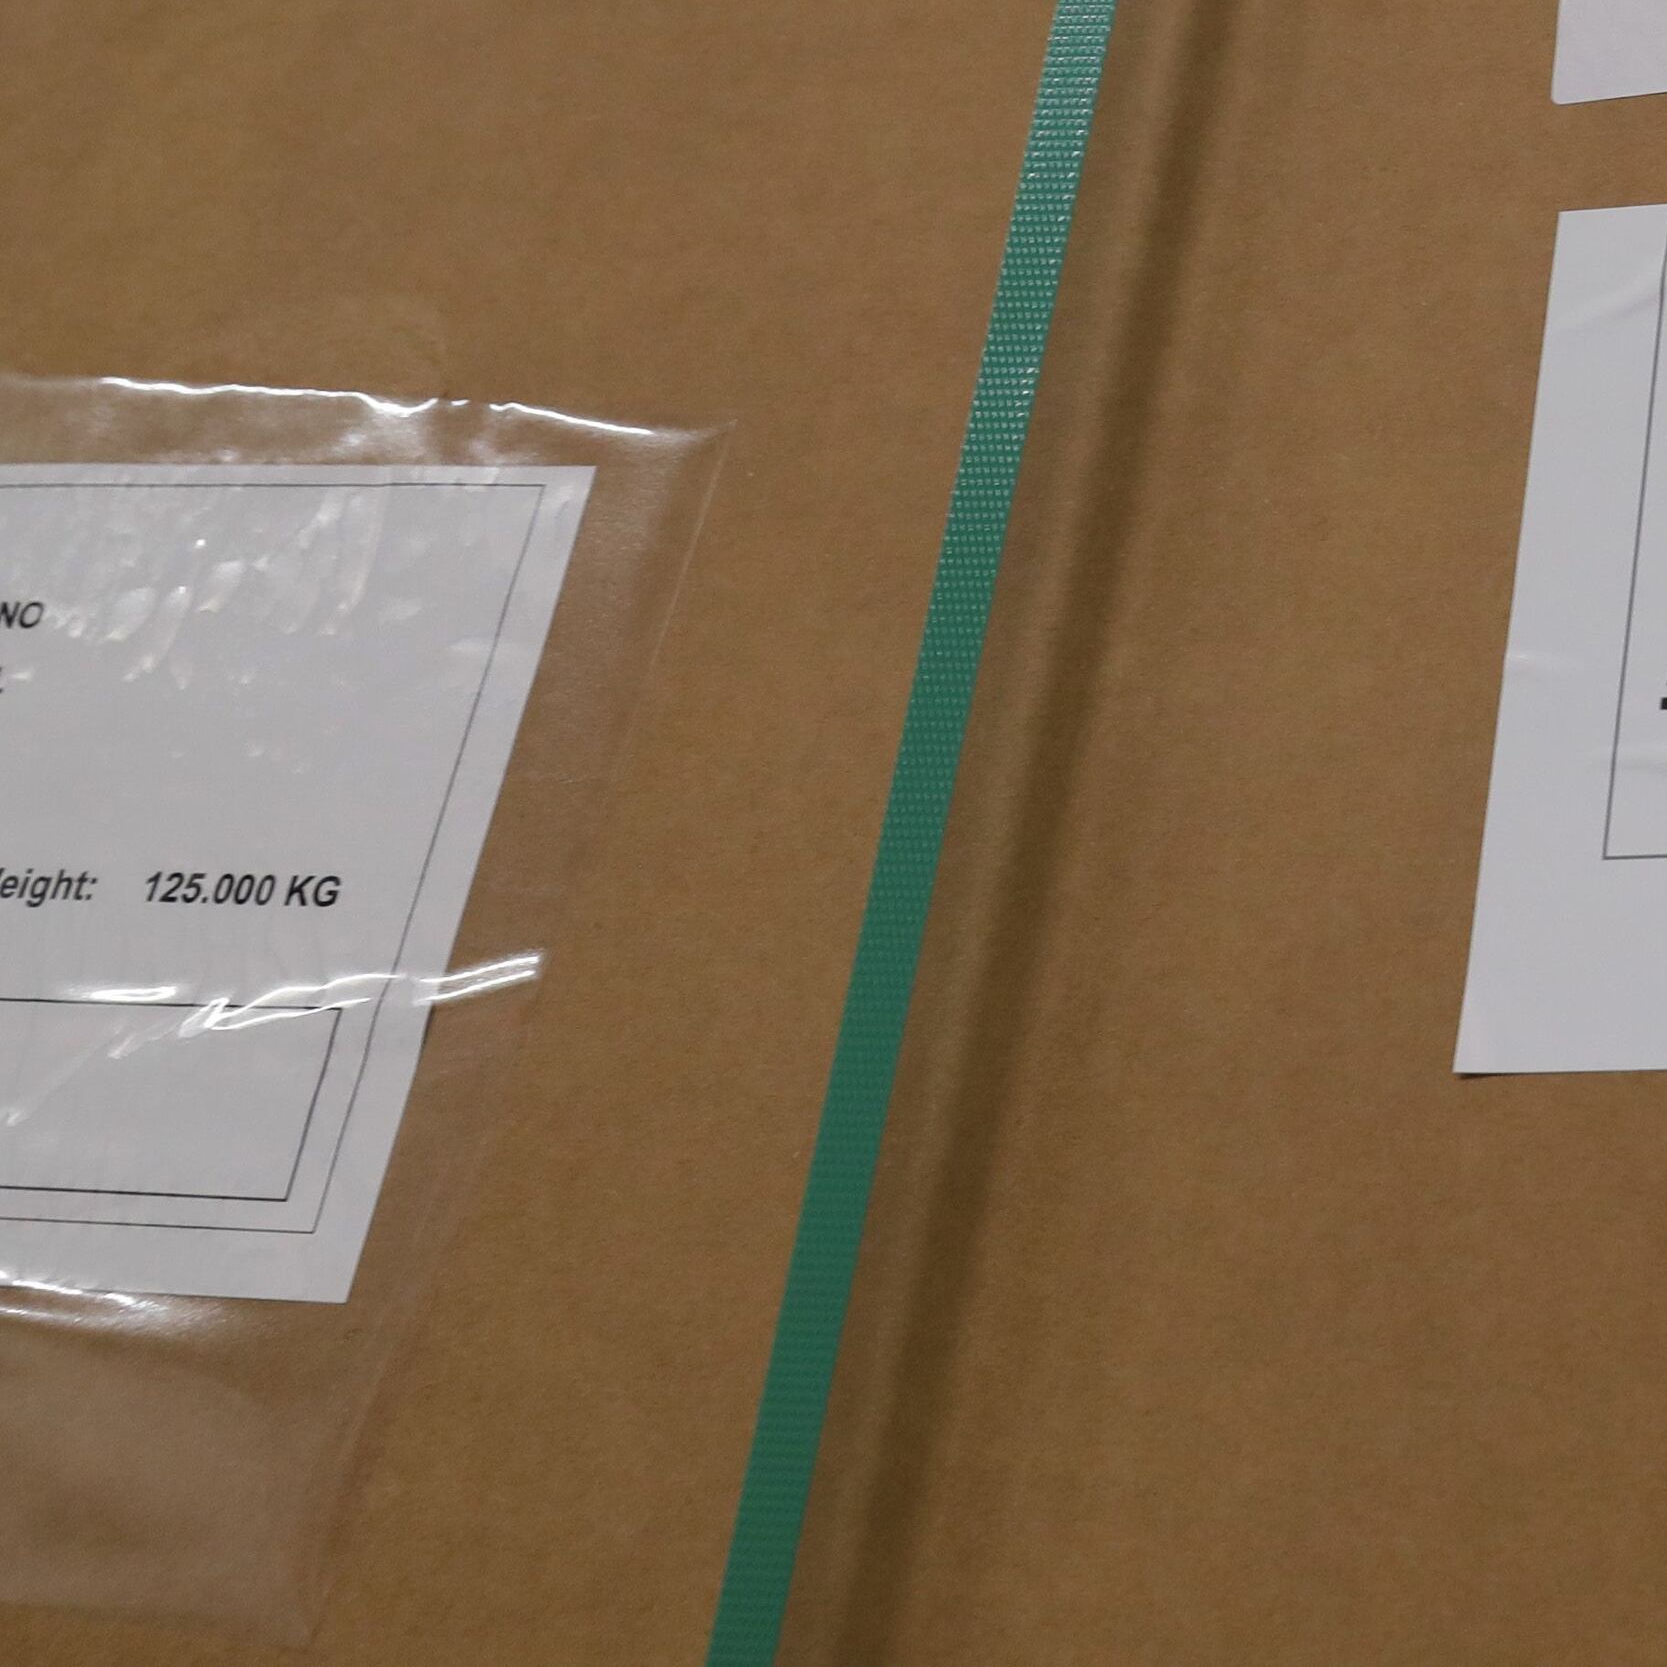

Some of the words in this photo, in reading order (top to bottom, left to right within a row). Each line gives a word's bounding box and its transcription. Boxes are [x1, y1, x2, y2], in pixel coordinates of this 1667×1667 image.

[0, 867, 98, 908] eight:
[145, 870, 277, 907] 125.000
[283, 874, 342, 908] KG
